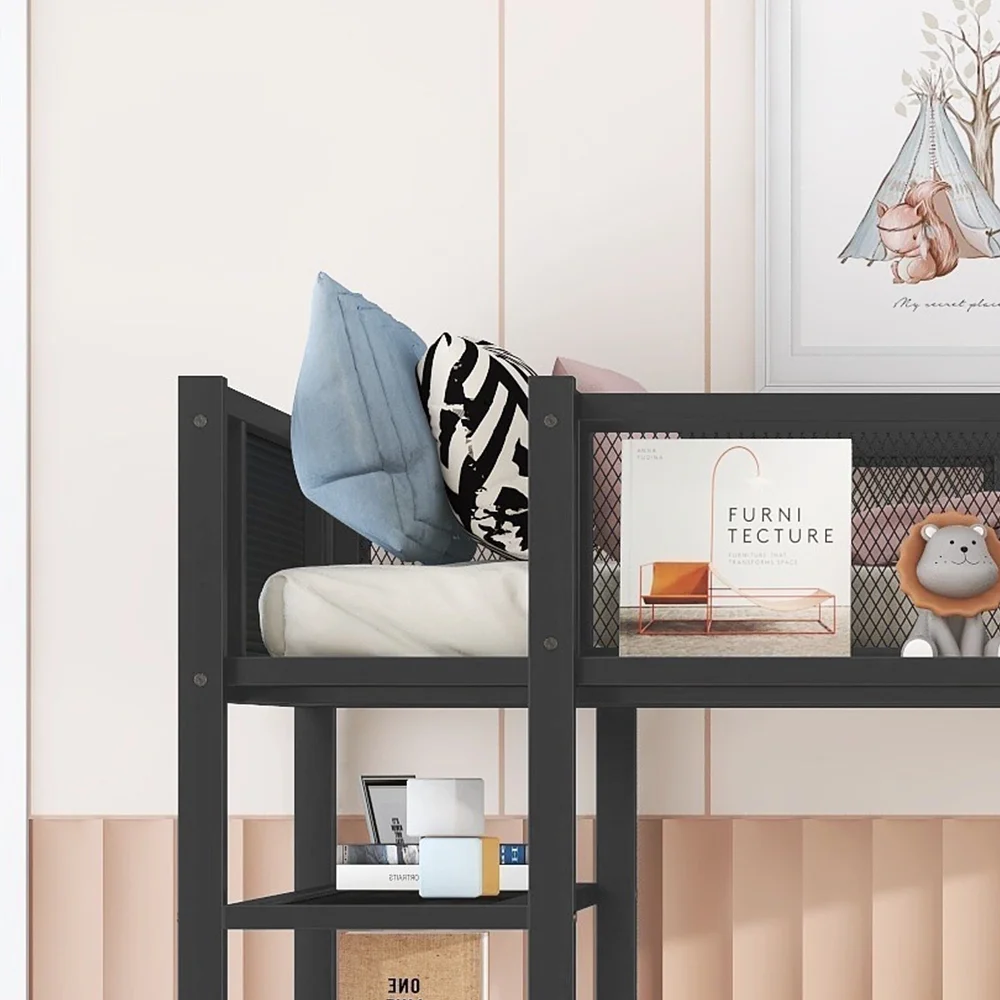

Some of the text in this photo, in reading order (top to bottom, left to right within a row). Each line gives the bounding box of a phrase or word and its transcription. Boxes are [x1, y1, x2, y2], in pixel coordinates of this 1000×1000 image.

[893, 297, 920, 312] My
[925, 299, 966, 308] secret
[728, 507, 801, 522] FURNI
[728, 528, 834, 543] TECTURE
